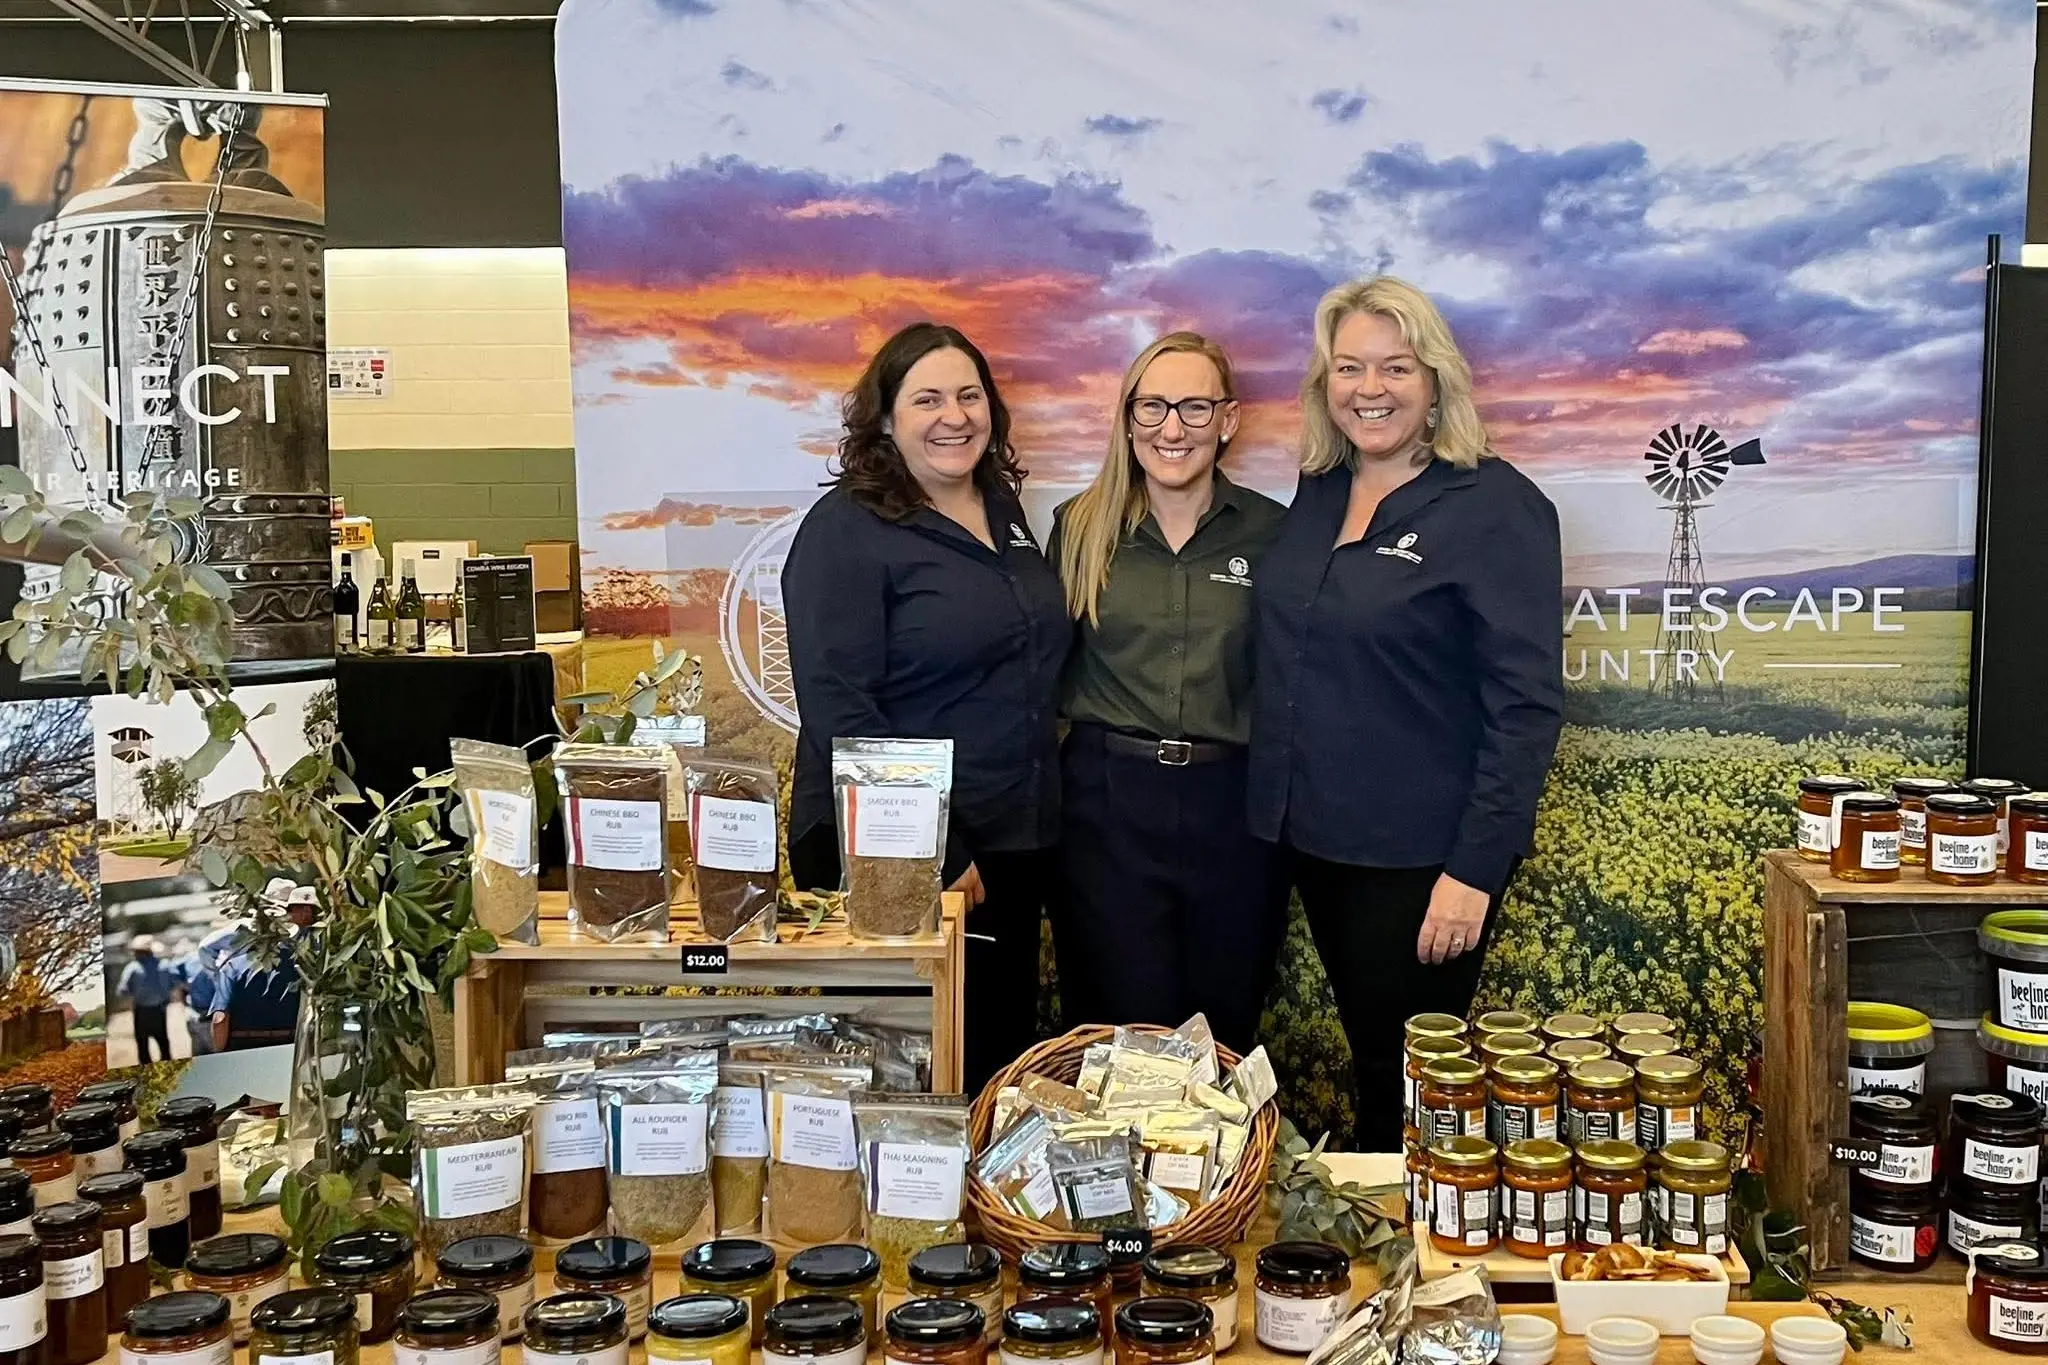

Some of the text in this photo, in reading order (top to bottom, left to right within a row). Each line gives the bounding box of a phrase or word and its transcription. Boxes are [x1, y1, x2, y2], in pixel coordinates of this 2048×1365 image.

[1662, 586, 1905, 633] ESCAPE
[901, 798, 918, 807] BBQ
[590, 808, 640, 819] CHINESE BBQ
[708, 809, 757, 822] CHINESE BBQ
[884, 810, 901, 818] RUB
[606, 820, 623, 829] RUB
[722, 822, 739, 832] RUB
[1939, 839, 1970, 856] beeline
[1953, 854, 1979, 868] honey
[686, 954, 725, 967] $12.00
[555, 1113, 573, 1122] BBQ
[793, 1104, 840, 1118] PORTUGUESE
[632, 1115, 688, 1125] ALL ROUNDER
[809, 1118, 824, 1128] RUB
[564, 1123, 582, 1132] RUB
[652, 1127, 669, 1136] RUB
[447, 1147, 518, 1165] MEDITERRANEAN
[883, 1152, 949, 1165] THAI SEASONING
[1835, 1147, 1877, 1162] $10.00
[1973, 1146, 2005, 1164] beeline
[474, 1163, 493, 1173] RUB
[906, 1166, 924, 1176] RUB
[1882, 1162, 1907, 1178] honey
[1988, 1159, 2014, 1179] honey
[1954, 1217, 1981, 1239] beeline
[1107, 1239, 1143, 1254] $4.00
[2000, 1303, 2034, 1321] beeline
[2016, 1319, 2044, 1337] honey
